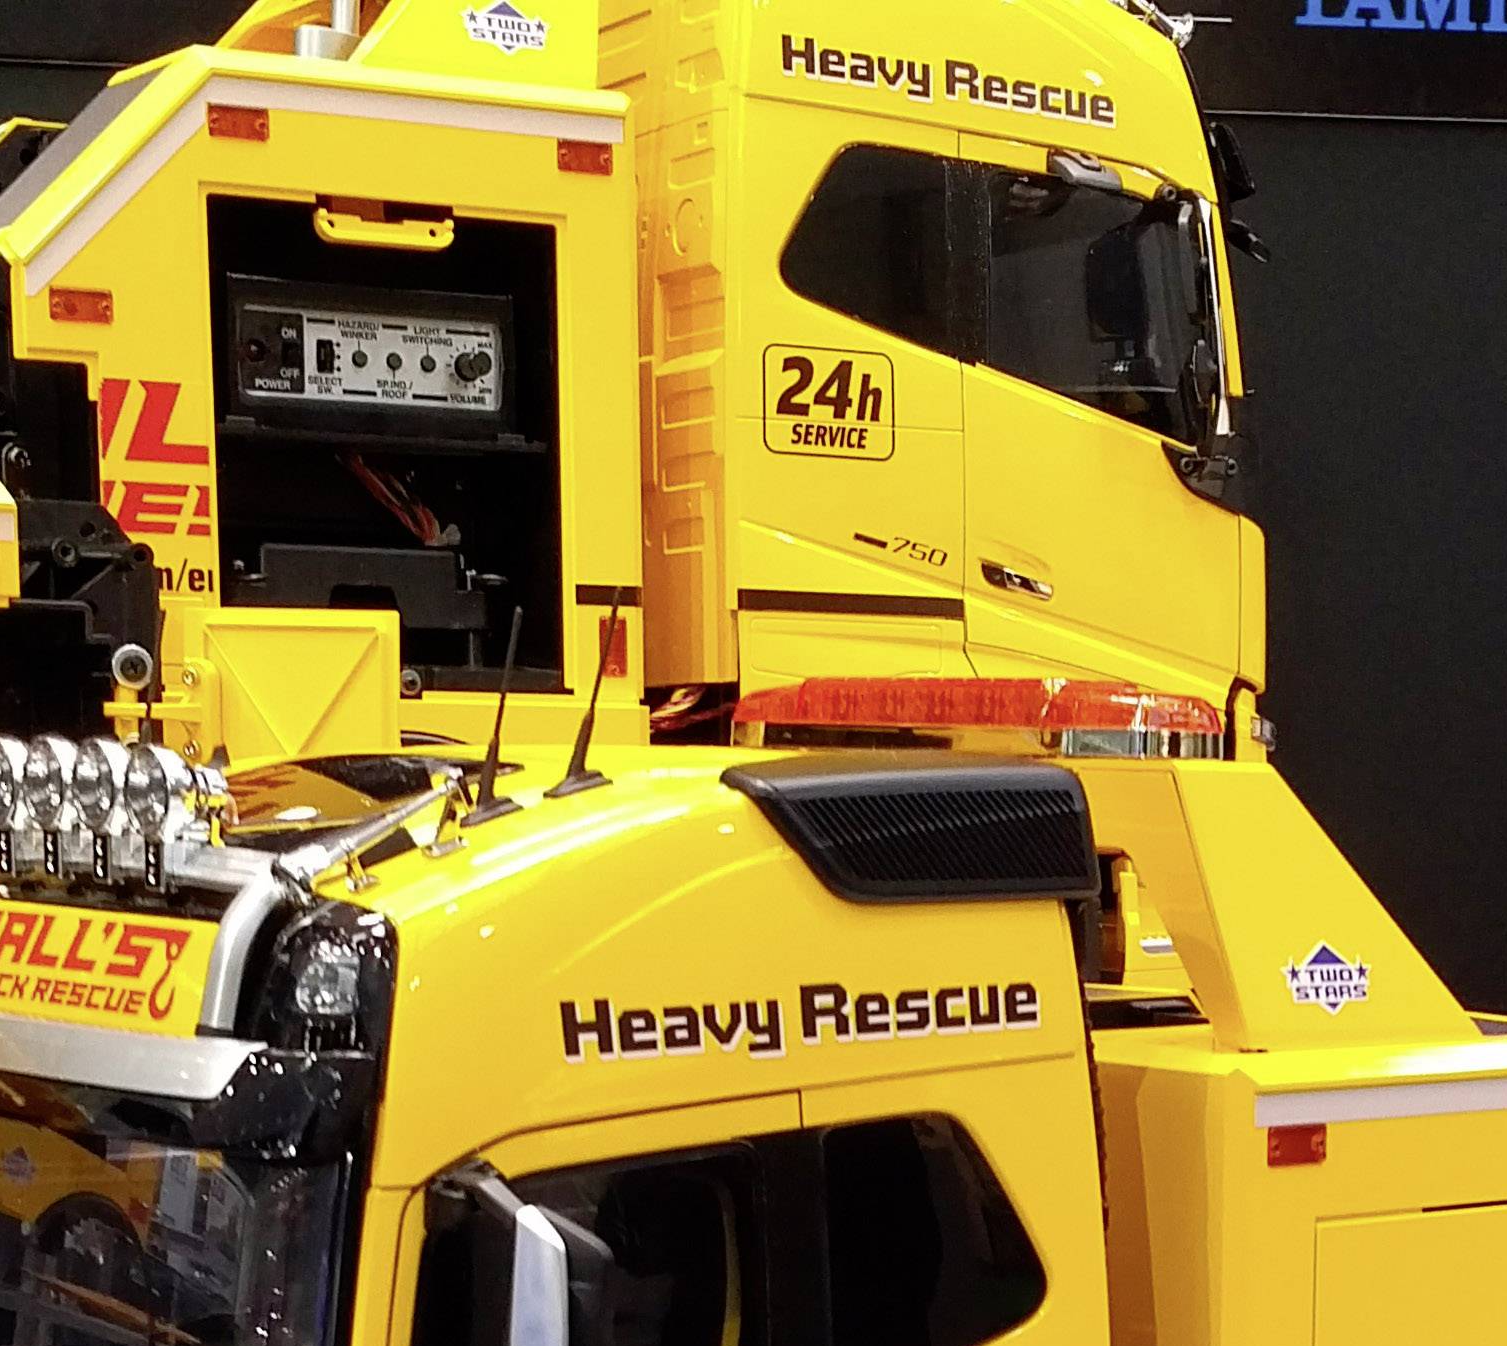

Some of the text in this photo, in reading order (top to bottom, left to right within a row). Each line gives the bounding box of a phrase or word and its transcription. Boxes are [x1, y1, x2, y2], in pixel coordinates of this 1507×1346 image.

[484, 16, 530, 32] TWO
[472, 28, 543, 46] STARS
[781, 34, 1114, 124] Heavy Rescue
[338, 319, 380, 332] HAZARD/
[413, 326, 440, 336] LIGHT
[281, 327, 297, 339] ON
[340, 330, 378, 341] WINKER
[401, 334, 453, 347] SWITCHING
[280, 368, 300, 379] OFF
[254, 378, 291, 390] POWER
[308, 376, 342, 386] SELECT
[317, 386, 334, 395] SW.
[381, 389, 407, 400] ROOF
[776, 356, 883, 422] 24h
[791, 423, 868, 450] SERVICE
[892, 537, 948, 567] 750
[1305, 969, 1353, 982] TWO
[31, 980, 146, 1014] RESCUE
[1296, 984, 1366, 1000] STARS
[560, 982, 1038, 1060] Heavy Rescue
